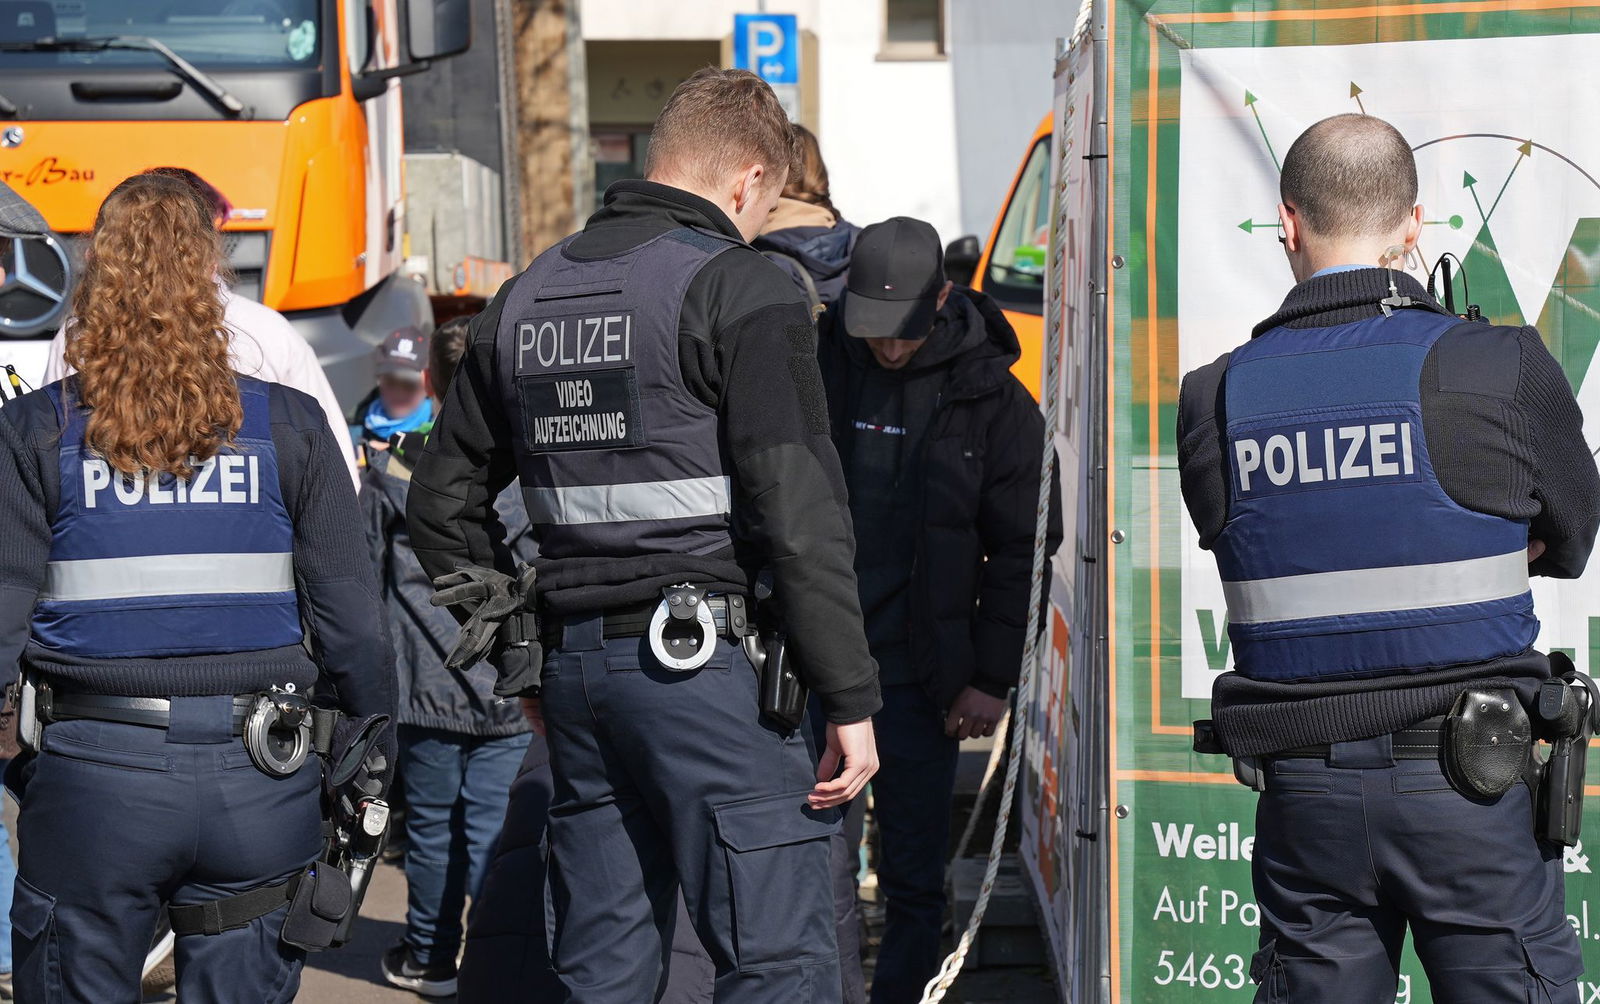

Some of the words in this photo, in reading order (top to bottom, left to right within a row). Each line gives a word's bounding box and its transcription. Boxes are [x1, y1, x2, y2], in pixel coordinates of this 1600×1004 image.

[748, 21, 785, 76] P
[518, 315, 631, 369] POLIZEI
[555, 379, 593, 408] VIDEO
[534, 411, 626, 444] AUFZEICHNUNG
[1234, 422, 1414, 492] POLIZEI
[83, 455, 259, 508] POLIZEI
[1151, 822, 1257, 861] Weile
[1153, 885, 1209, 924] Auf
[1221, 889, 1261, 927] Pa
[1566, 900, 1600, 940] el.
[1153, 950, 1262, 990] 5463
